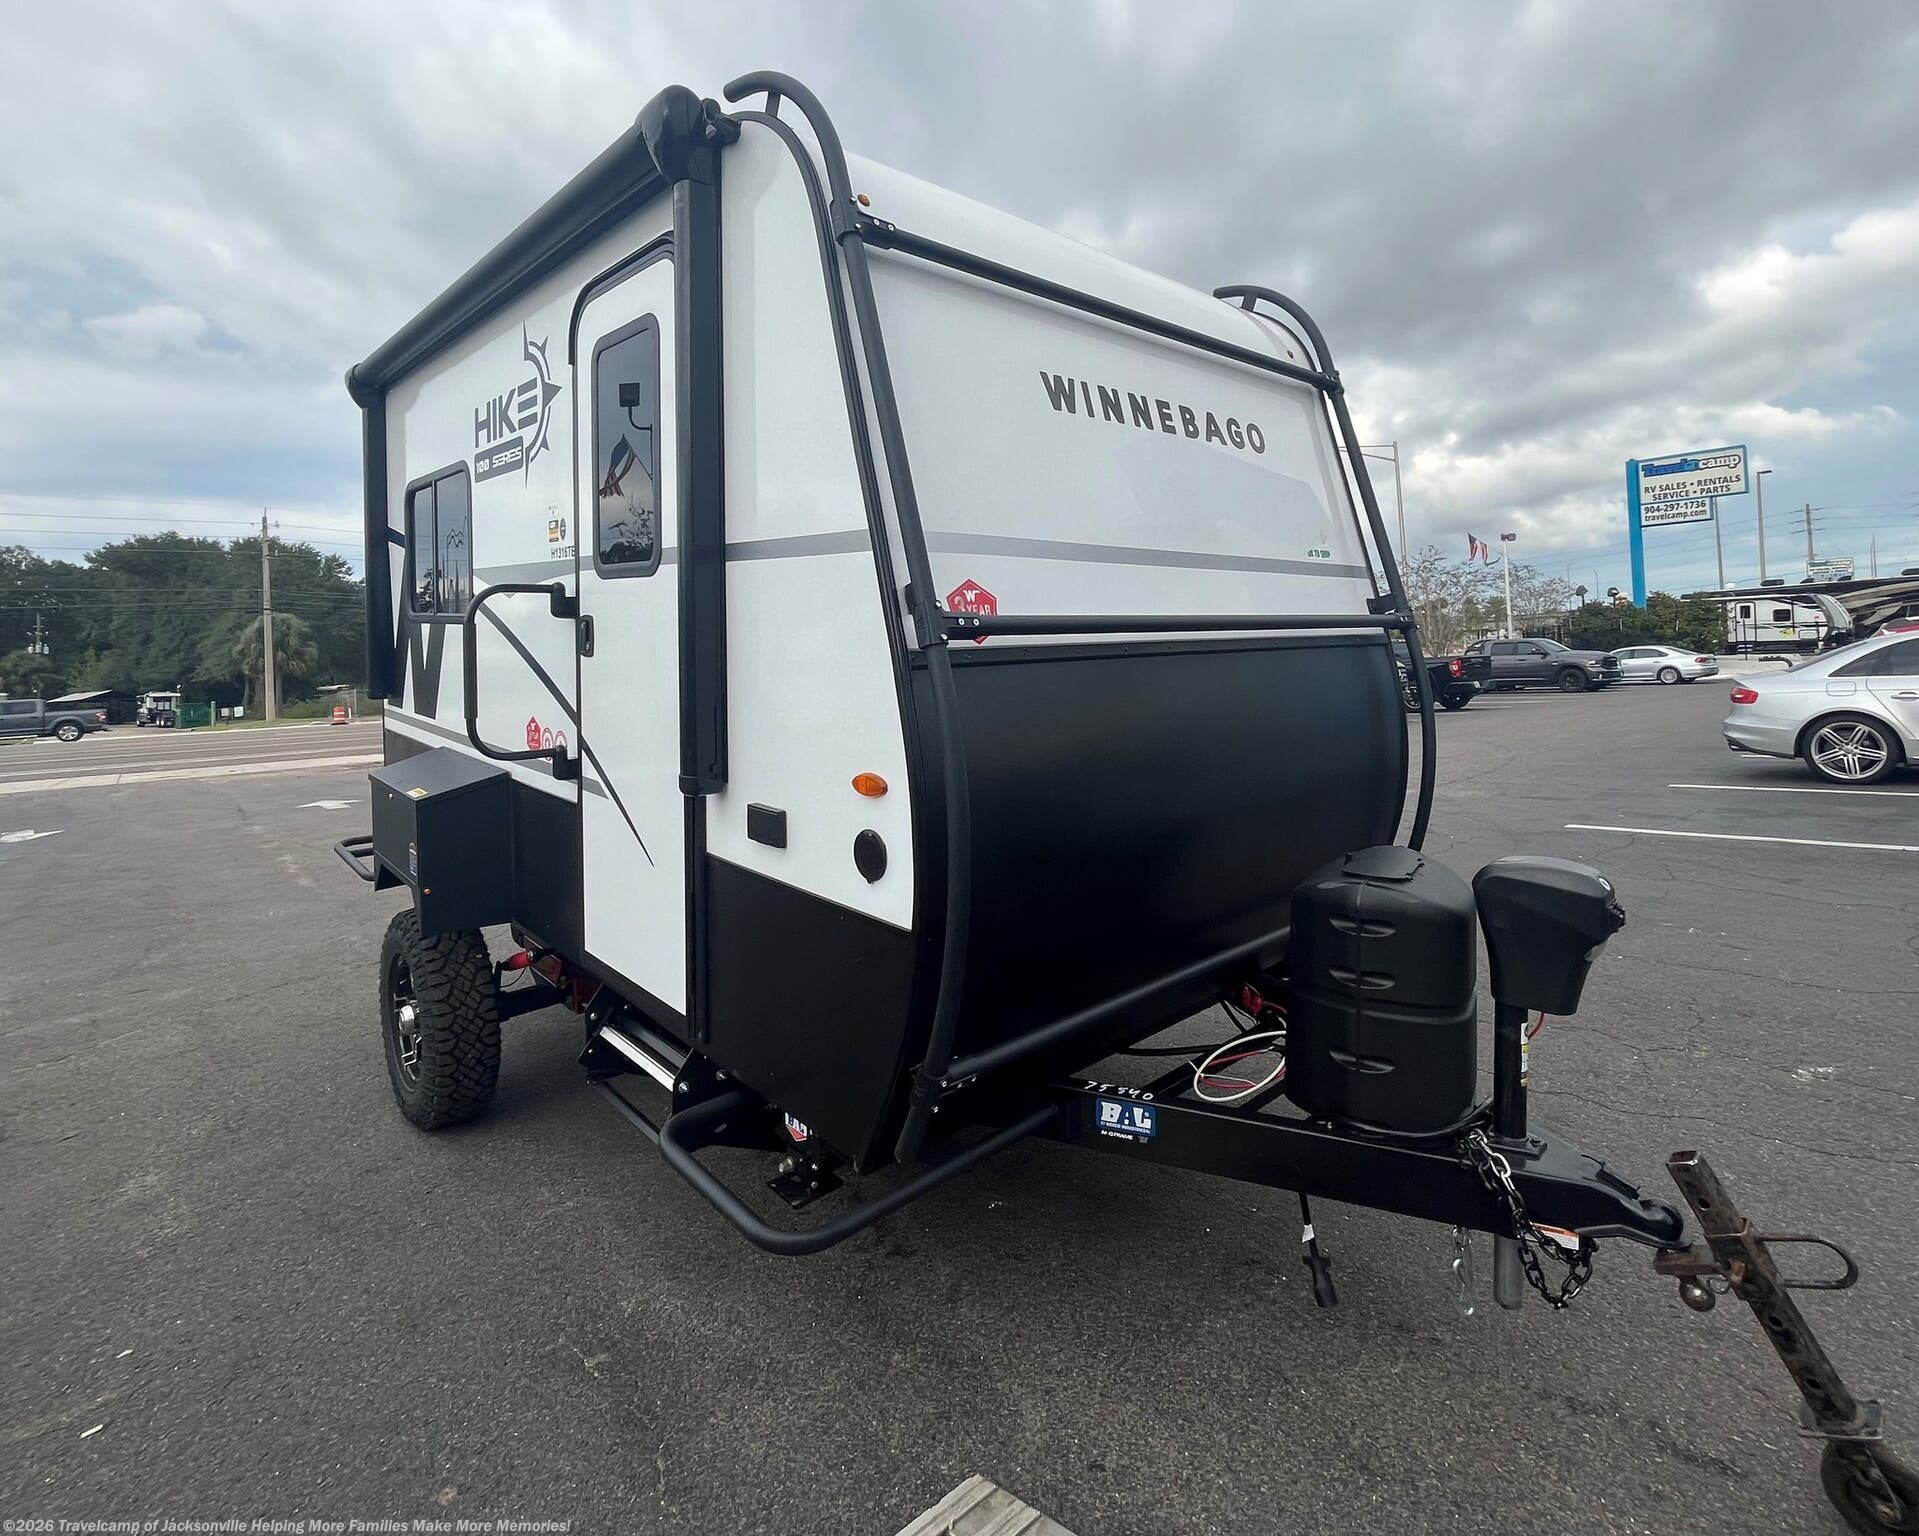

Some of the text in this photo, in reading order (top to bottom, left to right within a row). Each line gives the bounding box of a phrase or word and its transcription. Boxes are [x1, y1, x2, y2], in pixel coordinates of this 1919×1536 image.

[474, 377, 538, 449] HIKE
[1039, 370, 1266, 454] WINNEBAGO
[476, 446, 522, 474] 100 SERIES
[1644, 474, 1741, 494] RV SALES RENTALS
[1652, 484, 1731, 501] SERVICE PARTS
[1644, 500, 1706, 514] 904-297-1736
[1645, 508, 1707, 521] travelcamp.com
[1100, 1101, 1152, 1129] BAL
